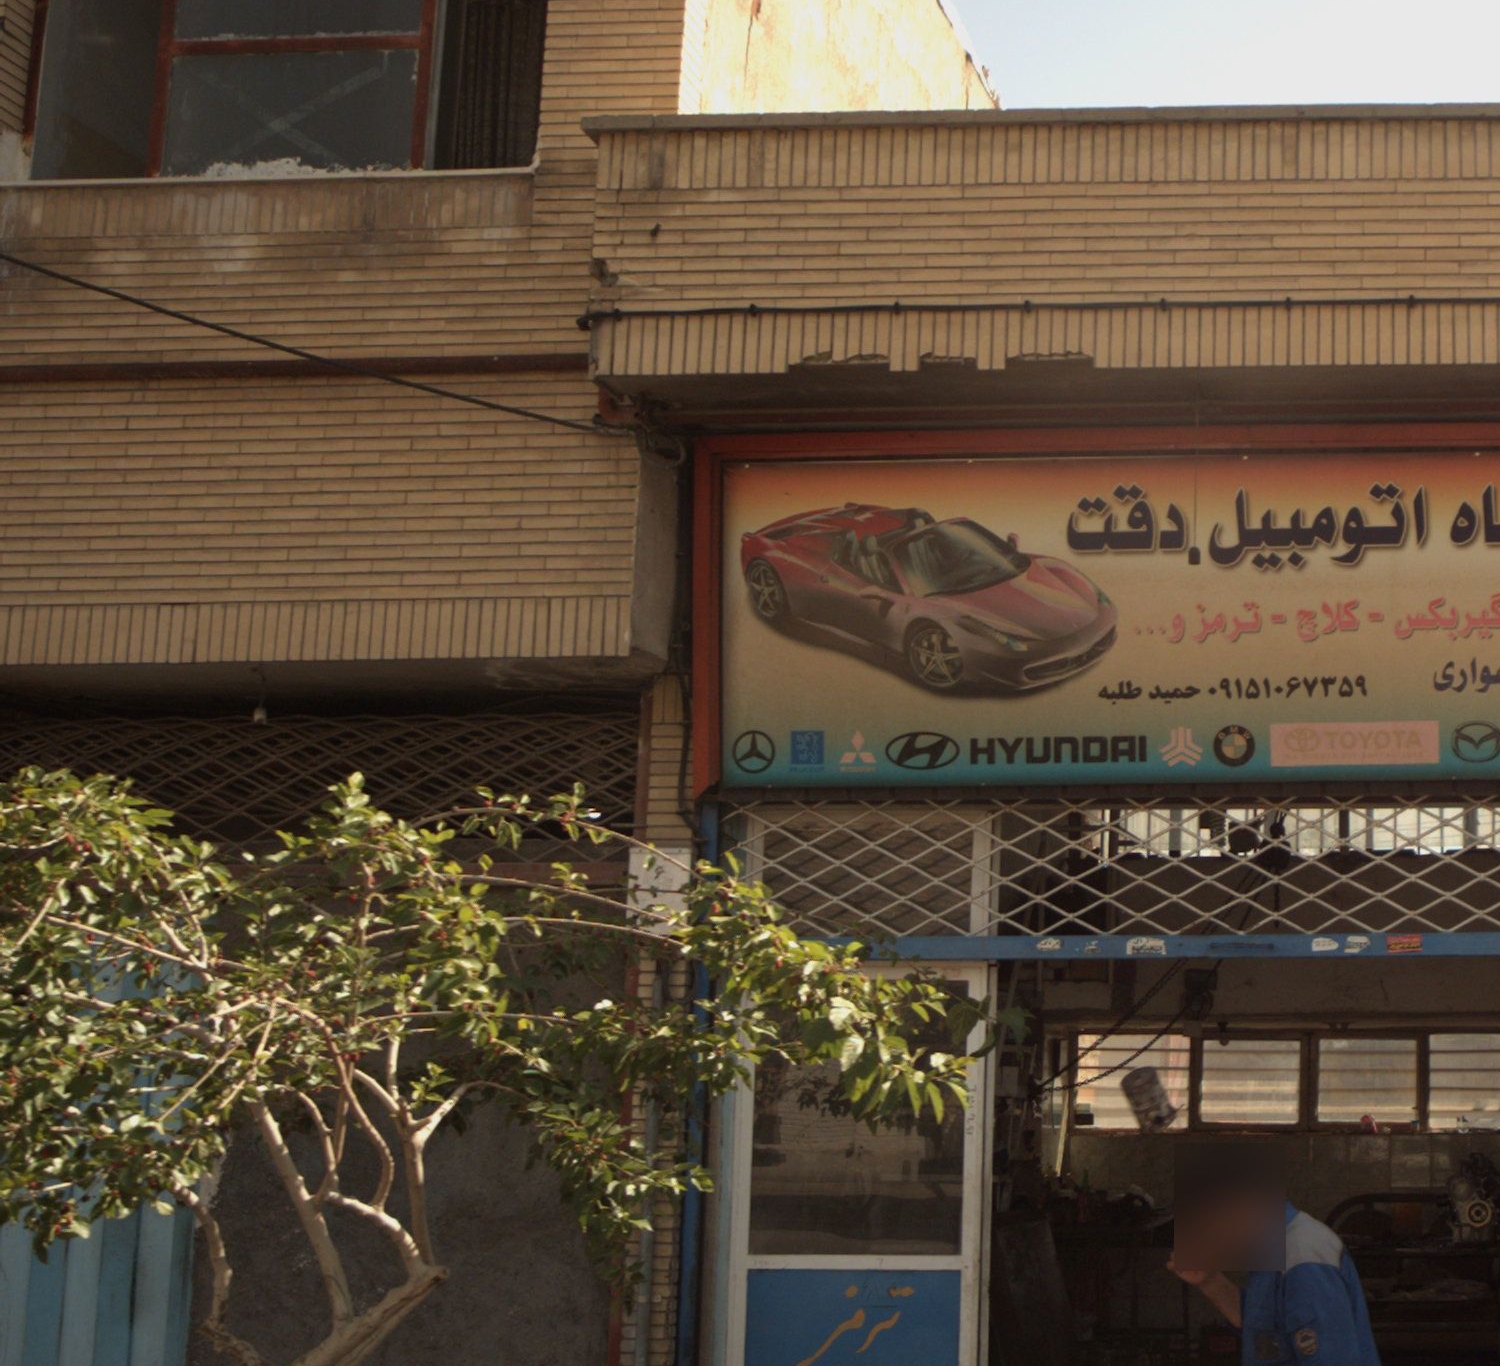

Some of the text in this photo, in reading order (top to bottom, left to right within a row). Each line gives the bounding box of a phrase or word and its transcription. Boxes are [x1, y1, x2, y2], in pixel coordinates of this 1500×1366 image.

[1065, 482, 1187, 554] دقت
[1208, 480, 1428, 570] اتومبیل
[1192, 602, 1262, 643] ترمز
[1295, 599, 1361, 641] کلاچ
[1097, 673, 1367, 704] ۰۹۱۵۱۰۶۷۳۵۹ حمید طلبه
[970, 736, 1148, 765] HYUNDAI
[1324, 730, 1423, 750] TOYOTA
